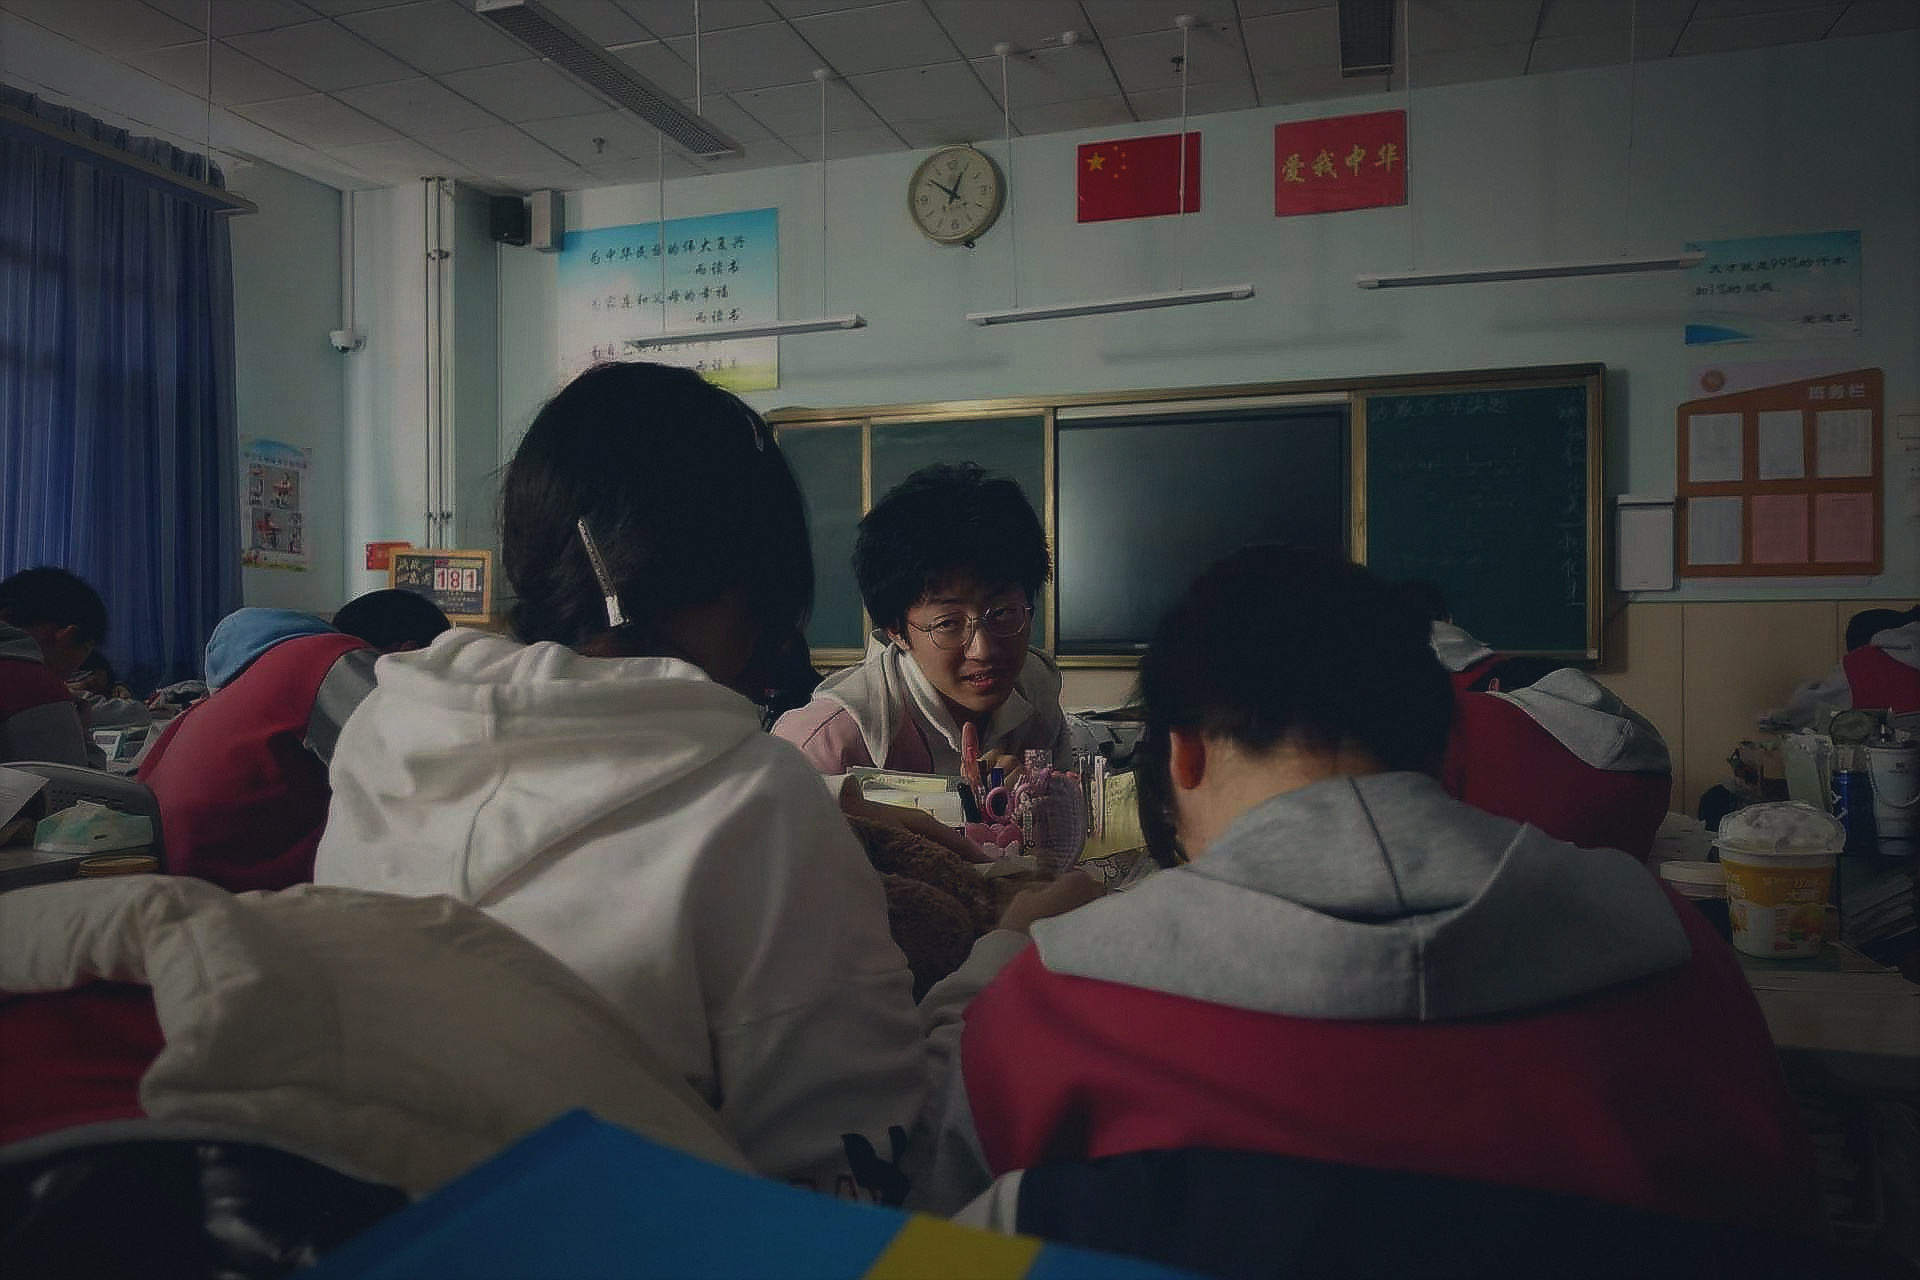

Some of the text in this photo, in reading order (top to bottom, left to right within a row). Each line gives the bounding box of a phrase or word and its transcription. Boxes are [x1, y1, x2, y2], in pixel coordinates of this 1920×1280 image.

[1280, 143, 1401, 184] 爱我中华
[436, 569, 475, 591] 181
